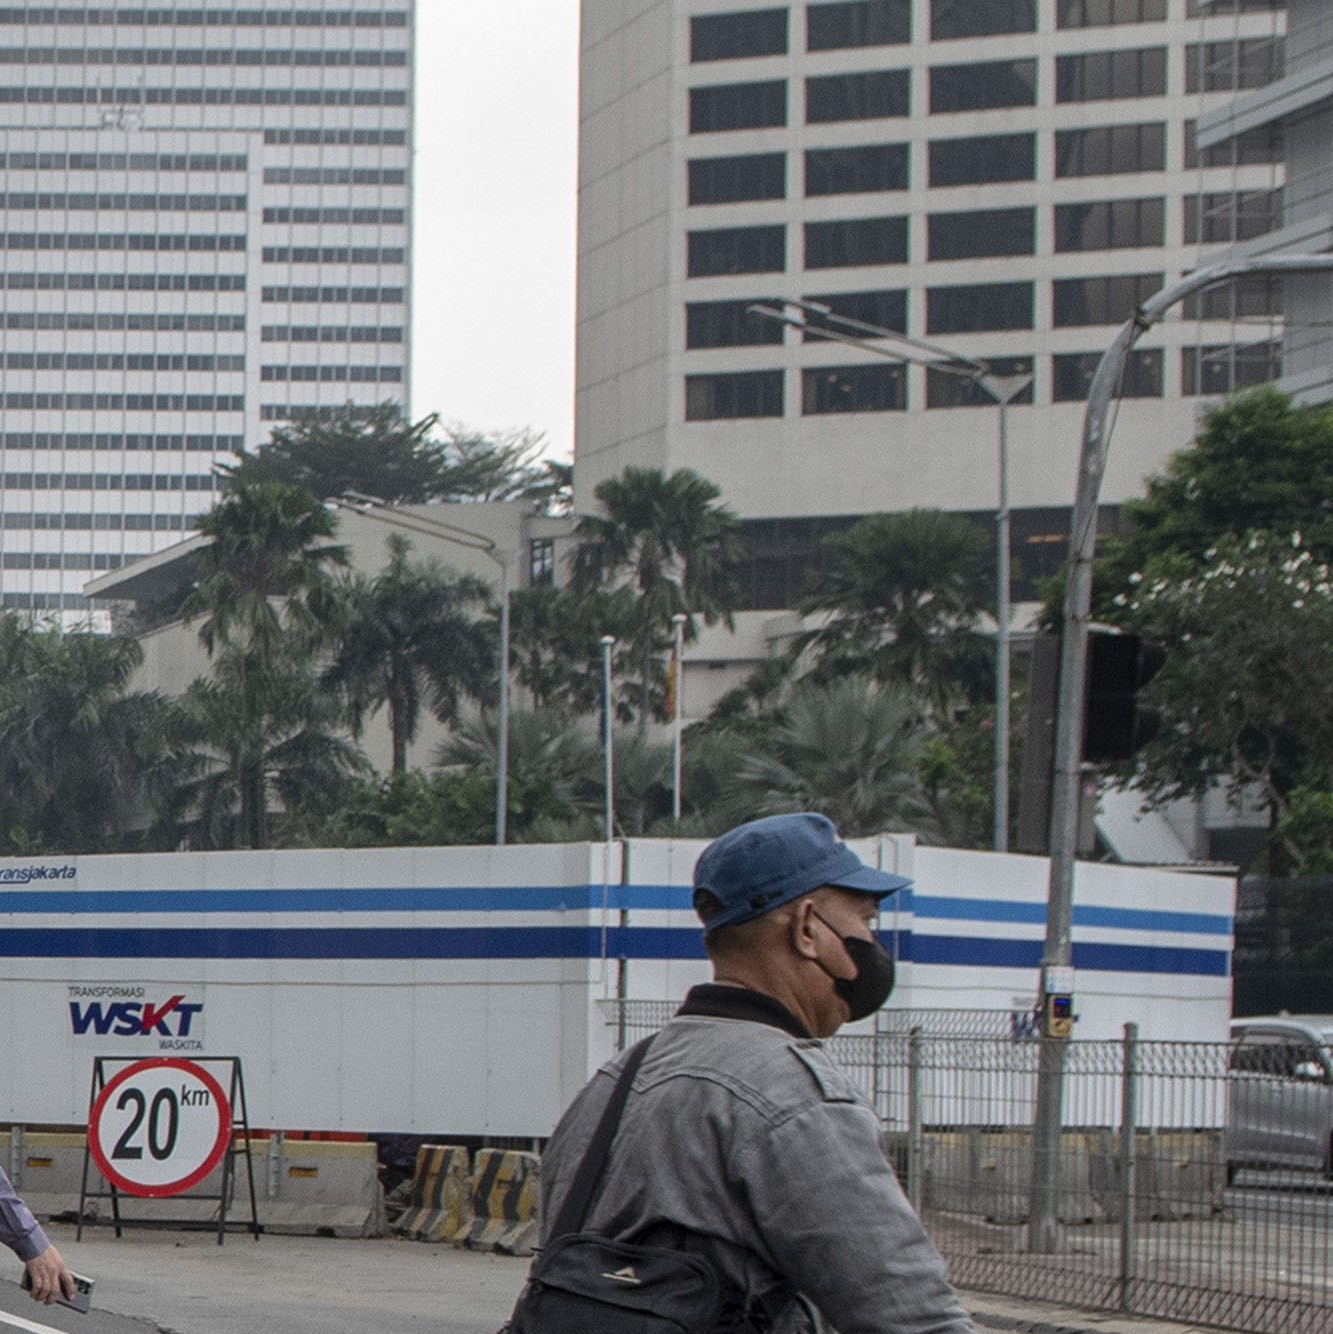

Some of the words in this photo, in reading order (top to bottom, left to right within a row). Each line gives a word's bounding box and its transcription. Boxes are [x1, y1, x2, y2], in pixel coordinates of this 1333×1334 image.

[68, 986, 145, 998] TRANSFORMASI
[69, 995, 204, 1037] WSKT
[159, 1039, 203, 1051] WASKITA
[111, 1087, 179, 1161] 20
[180, 1084, 210, 1107] km
